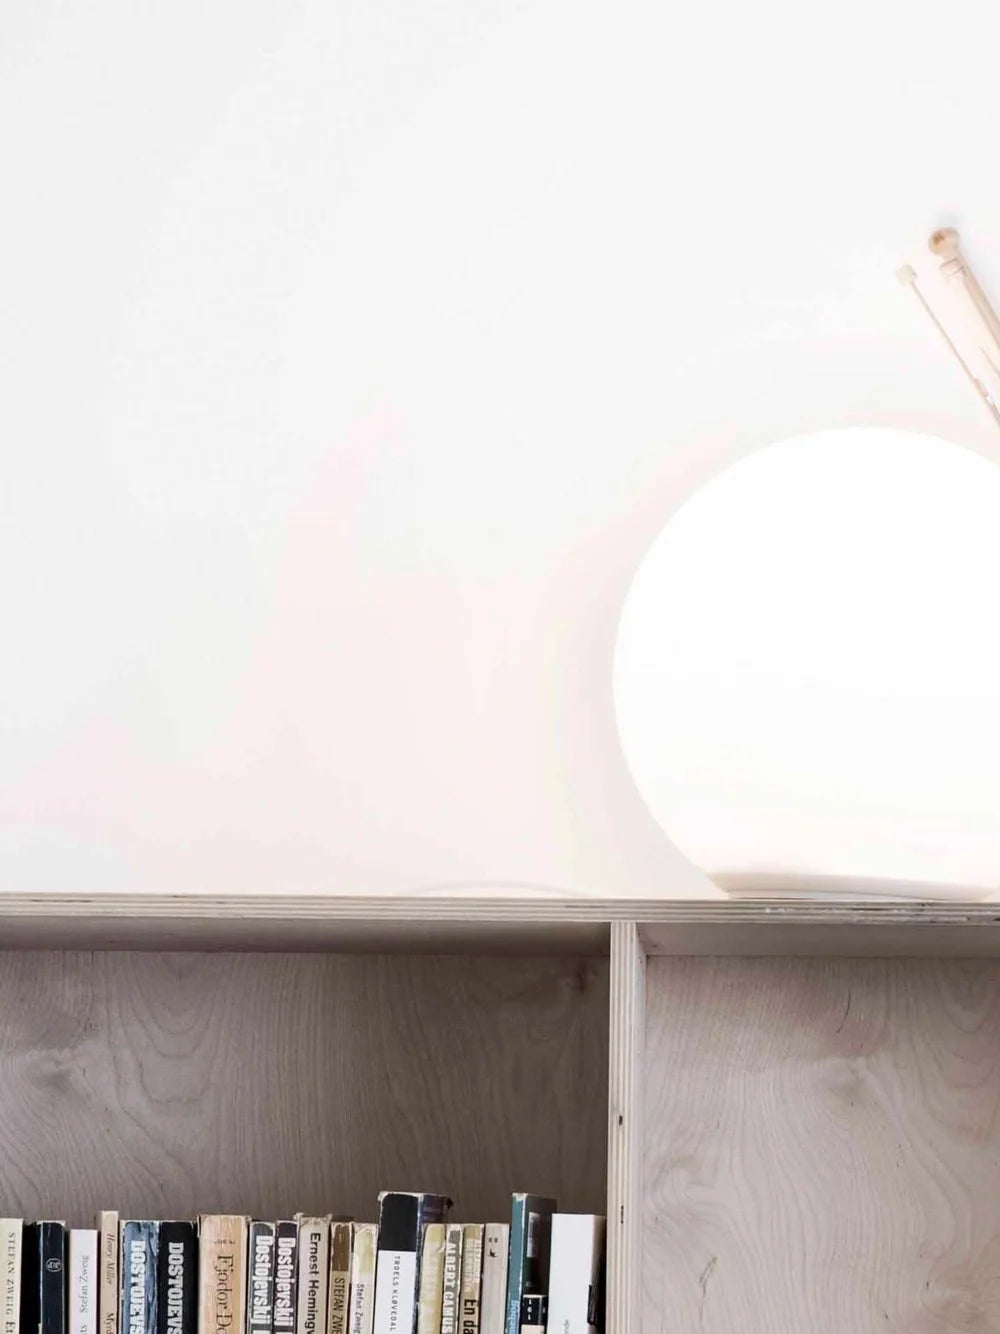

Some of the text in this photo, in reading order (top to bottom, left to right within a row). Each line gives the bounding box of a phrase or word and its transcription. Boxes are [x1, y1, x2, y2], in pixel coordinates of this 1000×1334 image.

[8, 1233, 16, 1275] STEFAN
[309, 1232, 321, 1275] Ernest
[6, 1278, 15, 1316] ZWEIG
[79, 1255, 90, 1313] Stefan Zweig
[214, 1255, 234, 1310] Fjodor
[250, 1235, 273, 1324] Dostojevskij
[274, 1237, 296, 1326] Dostojevskij
[332, 1278, 345, 1312] STEFAN
[355, 1283, 364, 1308] Stefan
[442, 1243, 458, 1333] ALBERT CAMUS
[6, 1321, 16, 1330] Et
[353, 1310, 363, 1334] Zweig
[390, 1289, 398, 1331] KLØVEDAL
[464, 1299, 477, 1315] En
